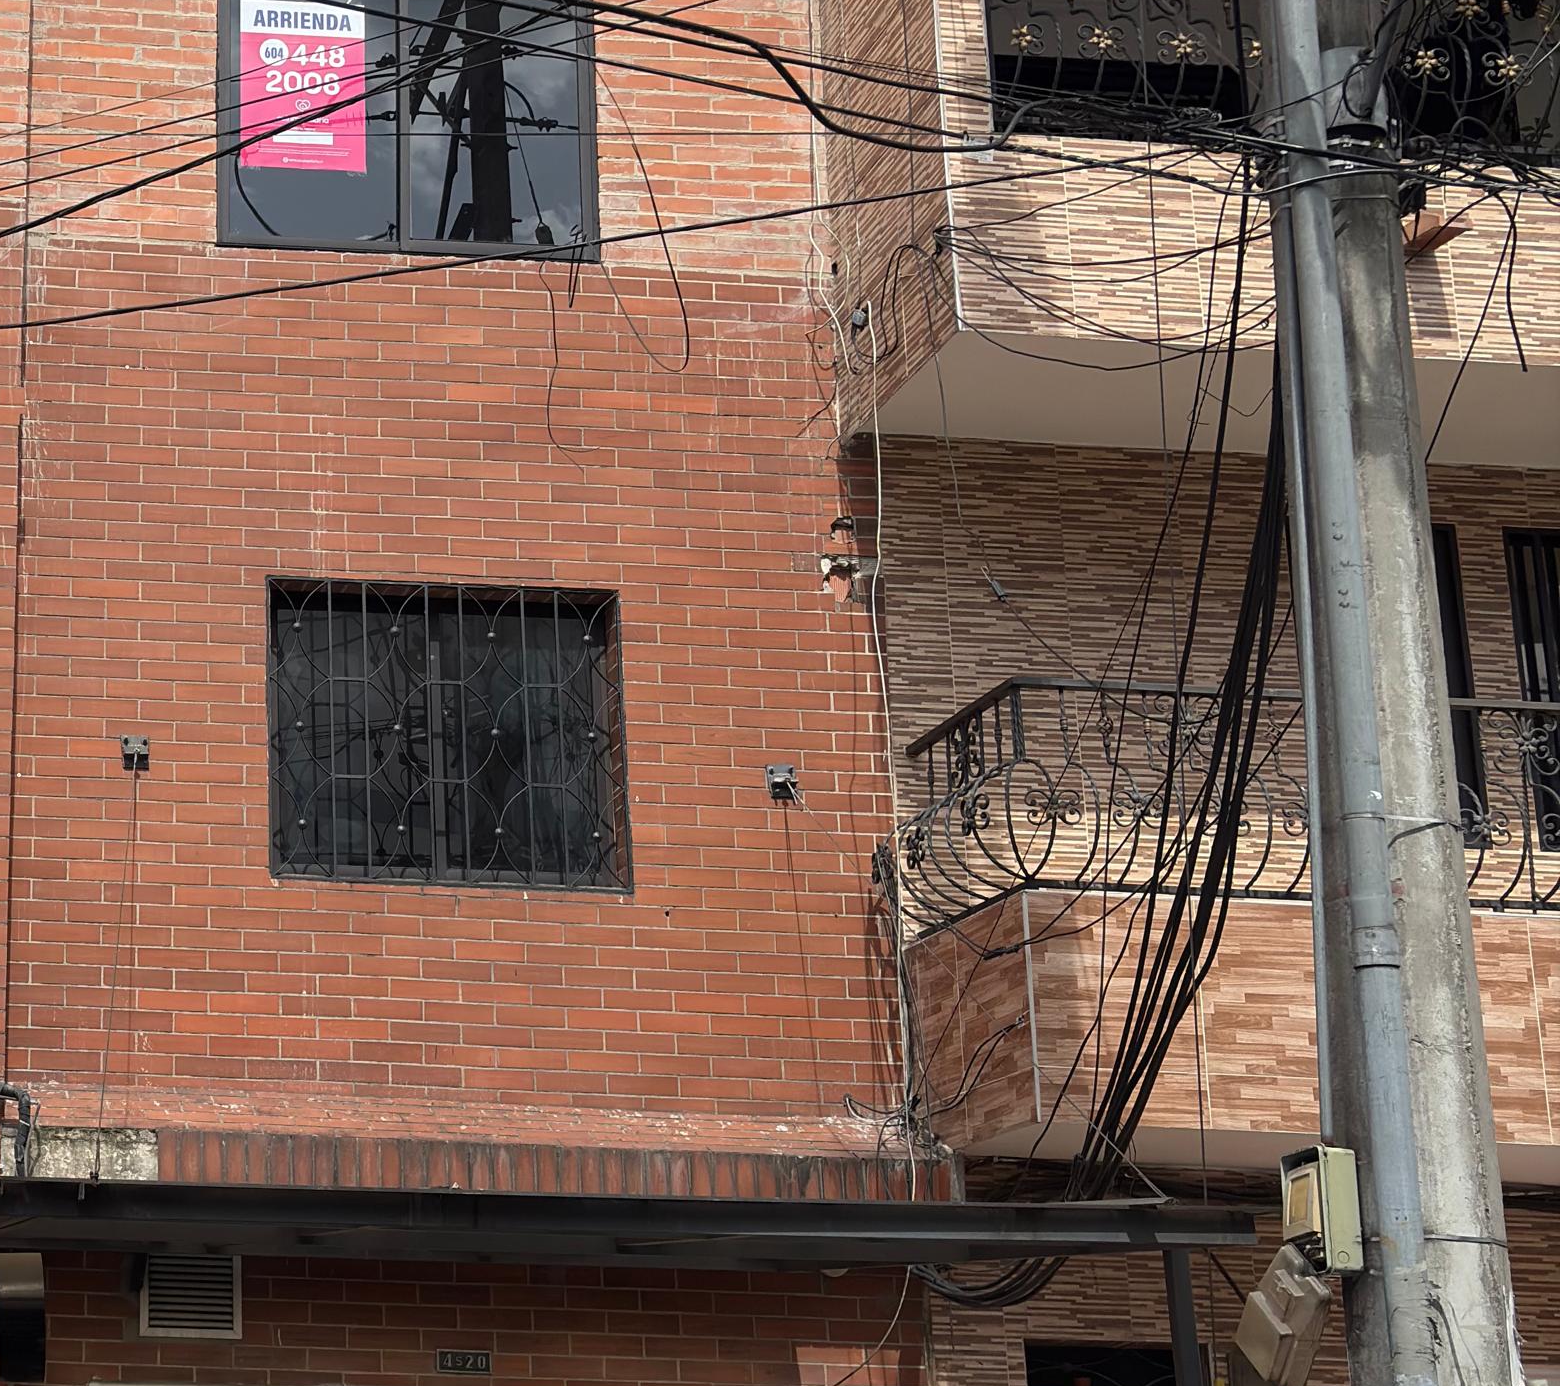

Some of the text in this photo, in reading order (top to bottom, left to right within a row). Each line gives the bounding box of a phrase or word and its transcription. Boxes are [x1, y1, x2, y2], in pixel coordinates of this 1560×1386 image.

[254, 10, 352, 31] ARRIENDA
[265, 44, 345, 67] 604 448
[265, 70, 340, 95] 2008
